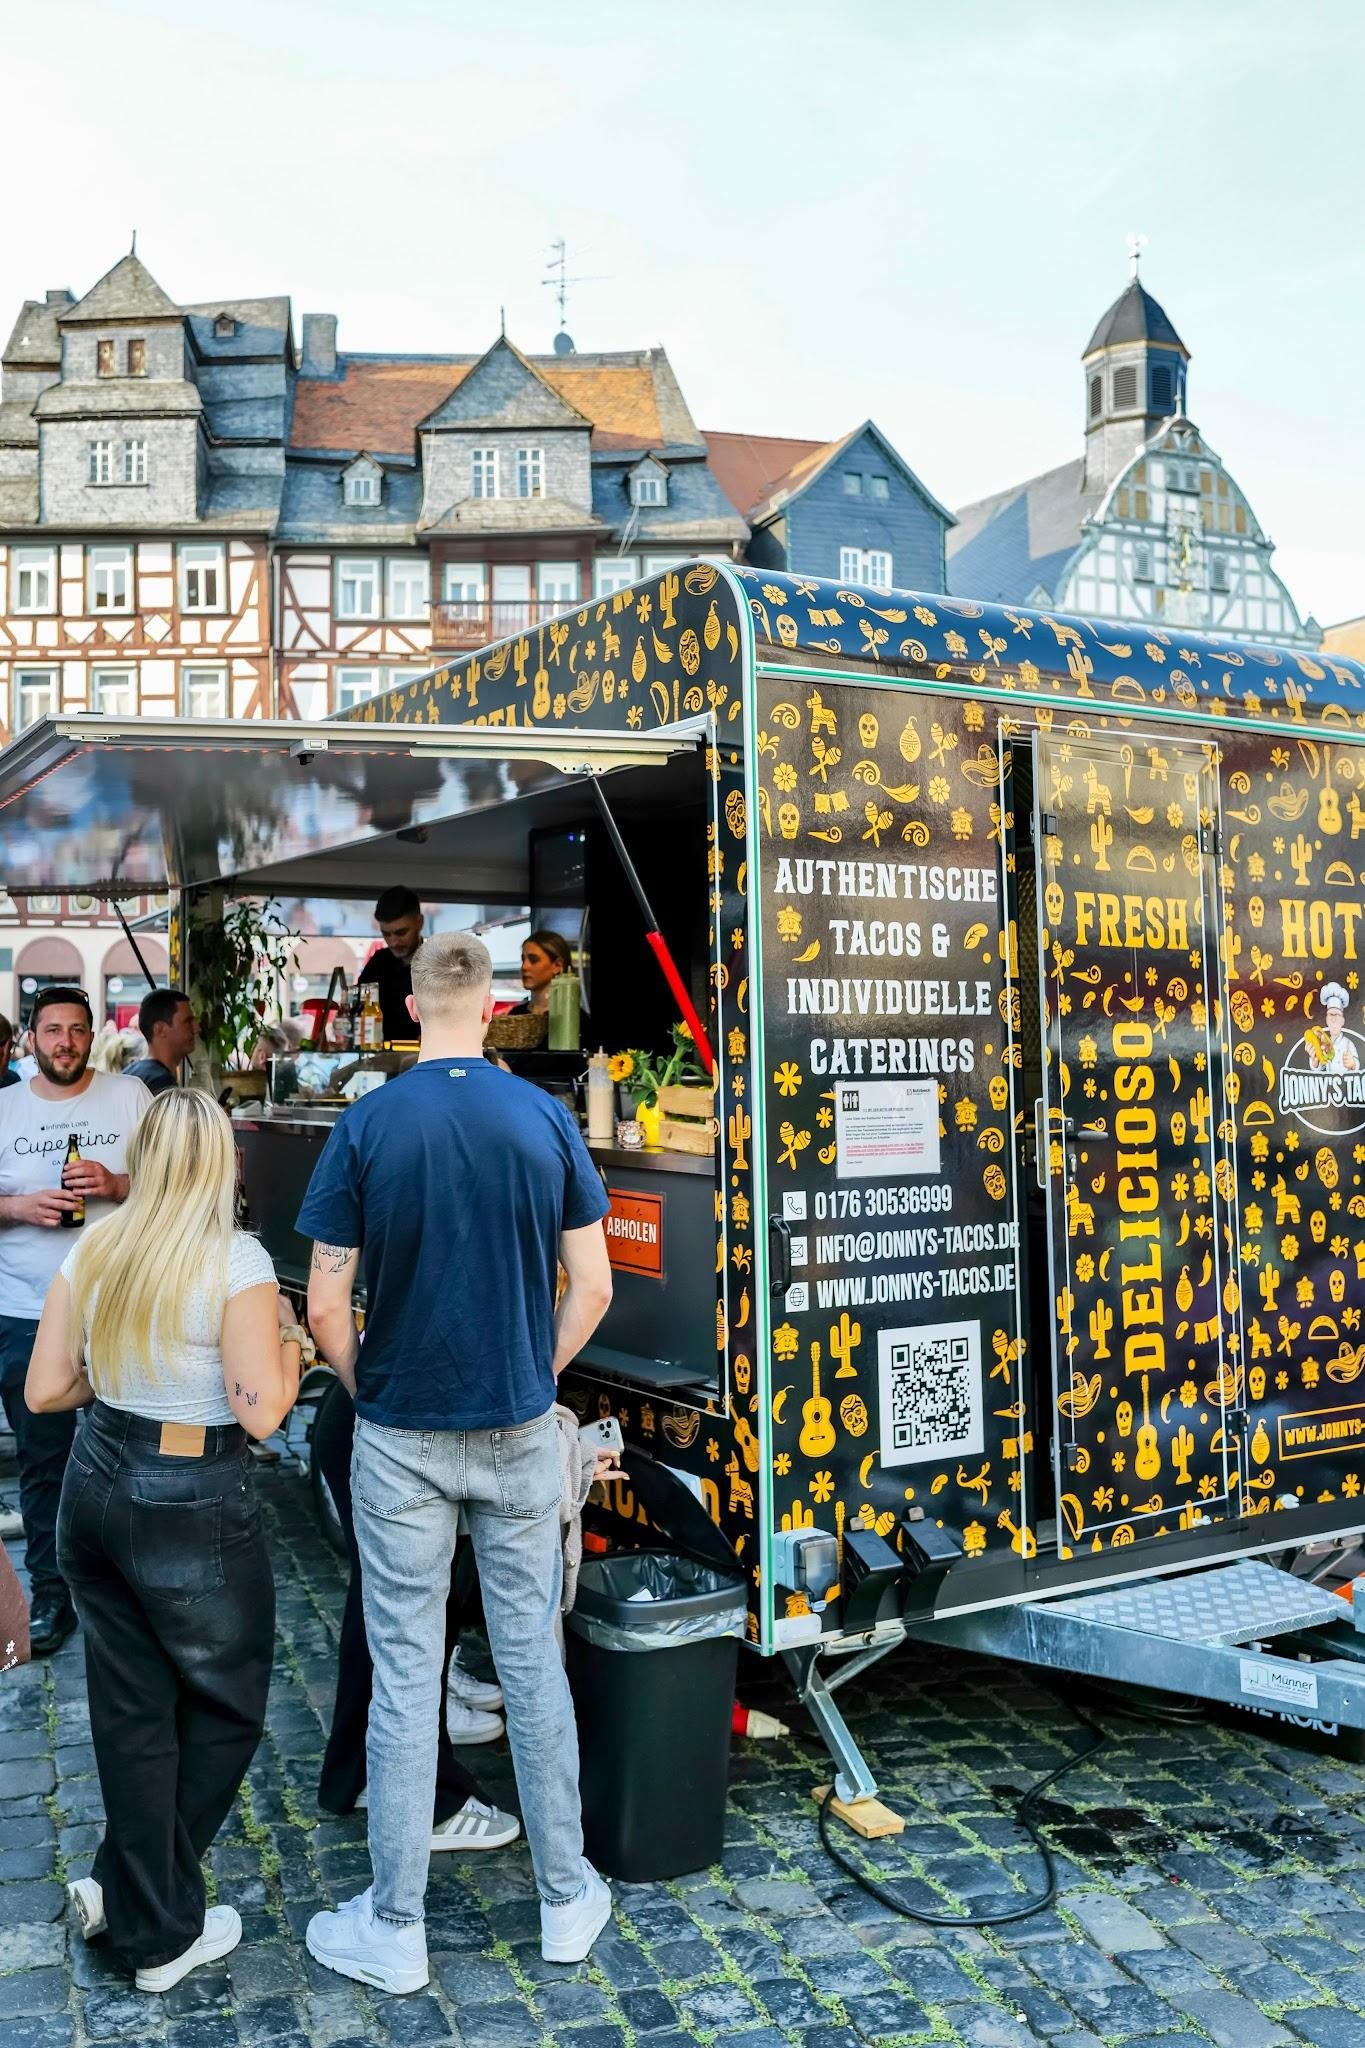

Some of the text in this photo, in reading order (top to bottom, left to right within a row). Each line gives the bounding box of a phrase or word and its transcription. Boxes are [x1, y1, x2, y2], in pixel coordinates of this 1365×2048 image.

[774, 857, 998, 903] AUTHENTISCHE
[829, 919, 950, 958] TACOS &
[1073, 891, 1190, 950] FRESH
[1278, 898, 1363, 960] HOT
[786, 977, 992, 1016] INDIVIDUELLE
[810, 1037, 975, 1075] CATERINGS
[1282, 1073, 1342, 1107] JONNY'S
[14, 1130, 121, 1158] Cupetino
[814, 1184, 953, 1220] 0176 30536999
[1112, 1020, 1166, 1377] DELICIOSO
[606, 1216, 657, 1244] ABHOLEN
[816, 1221, 1021, 1265] INFO@JONNYS-TACOS.DE
[816, 1263, 1016, 1309] WWW.JONNYS-TACOS.DE
[1271, 1673, 1313, 1690] Münner
